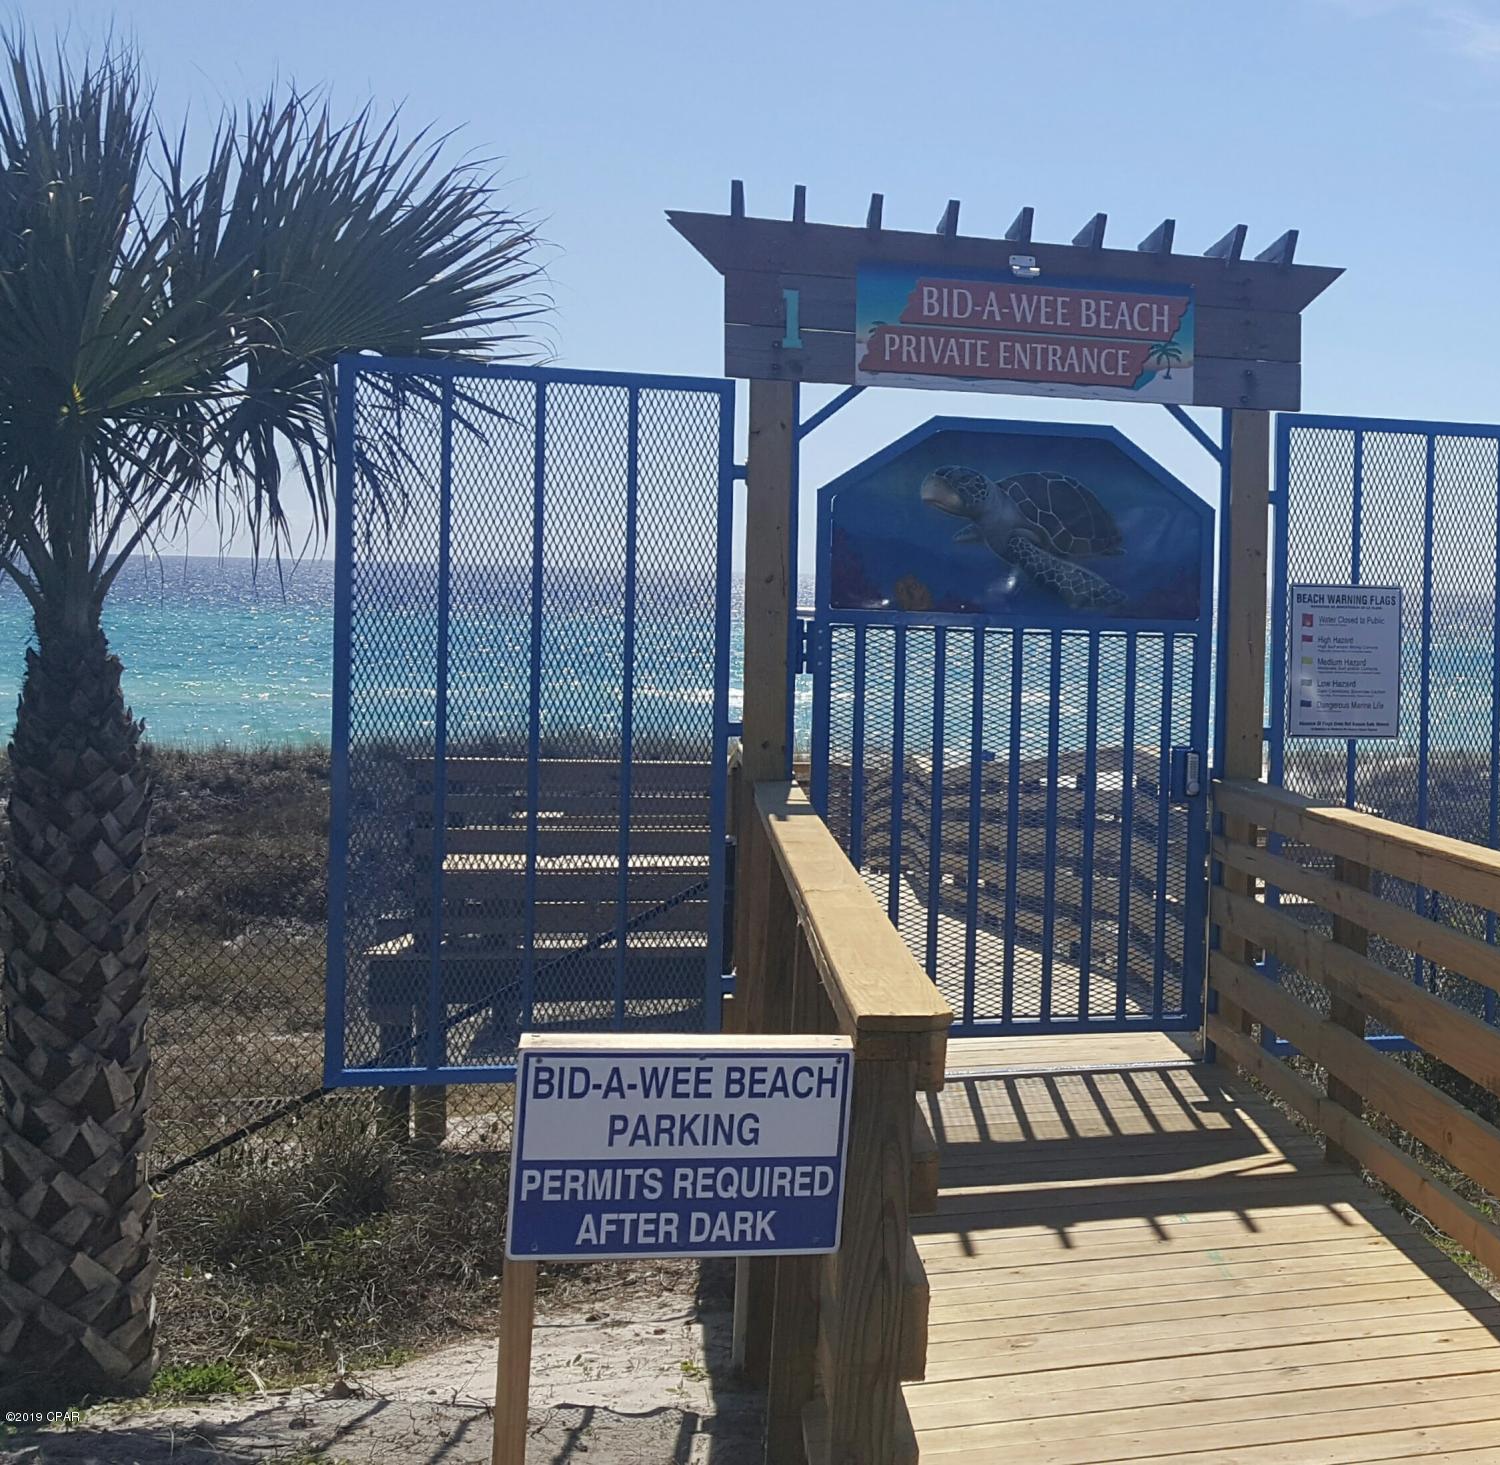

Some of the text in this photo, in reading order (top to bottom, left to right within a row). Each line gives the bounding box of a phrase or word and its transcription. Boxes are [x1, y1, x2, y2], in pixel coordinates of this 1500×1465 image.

[782, 288, 802, 349] 1
[922, 286, 1170, 333] BID-A-WEE BEACH
[884, 333, 1131, 376] PRIVATE ENTRANCE
[1296, 593, 1396, 606] BEACH WARNING FLAGS
[1337, 616, 1359, 624] Closed
[1367, 616, 1385, 625] Public
[532, 1065, 838, 1100] BID-A-WEE BEACH
[607, 1113, 760, 1147] PARKING
[521, 1165, 834, 1201] PERMITS REQUIRED
[575, 1210, 777, 1246] AFTER DARK
